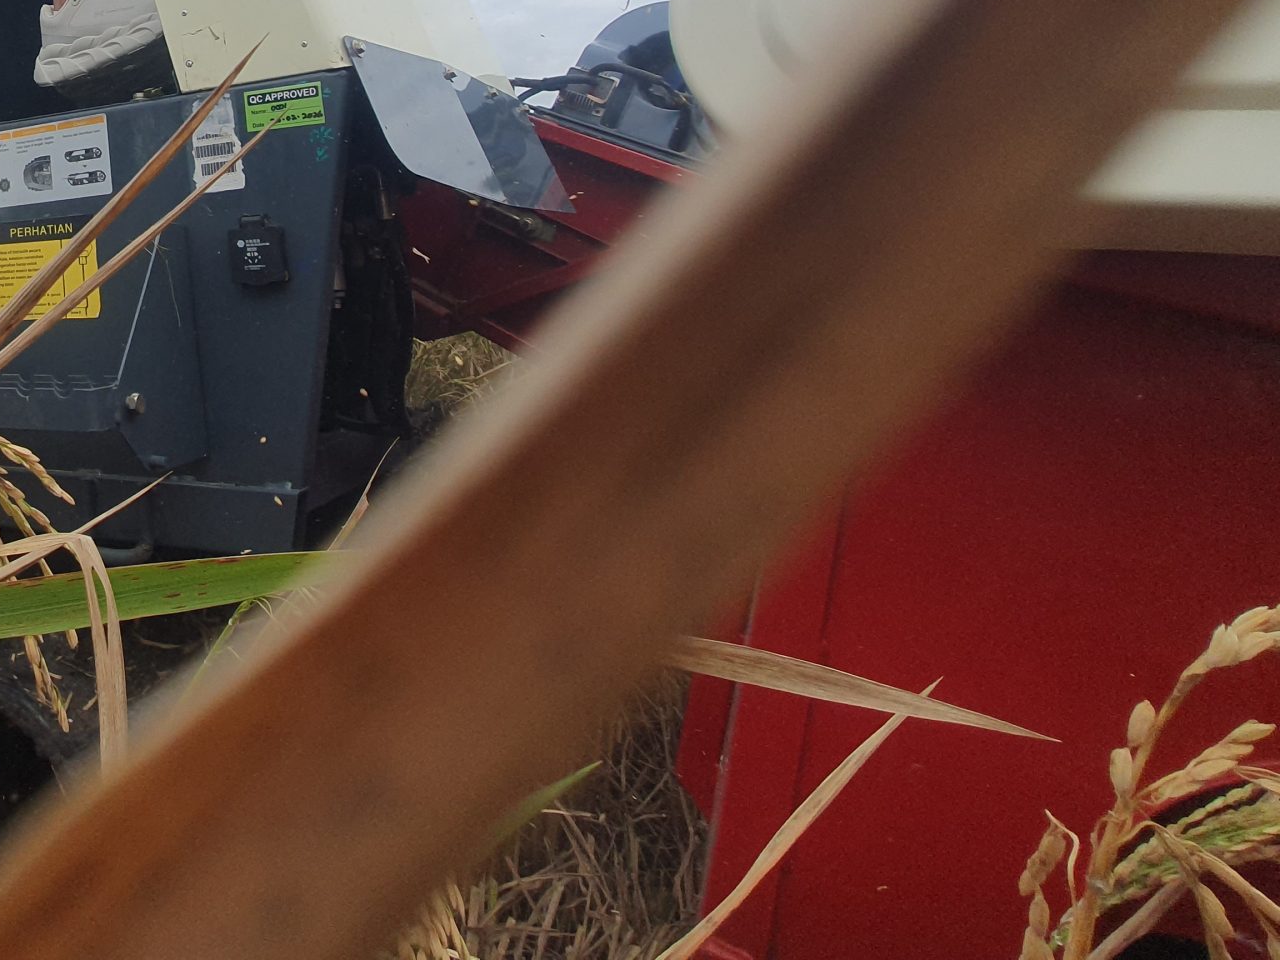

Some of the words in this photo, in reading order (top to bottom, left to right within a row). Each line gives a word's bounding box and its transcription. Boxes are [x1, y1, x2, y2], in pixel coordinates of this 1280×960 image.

[249, 94, 263, 104] QC
[265, 87, 317, 102] APPROVED
[10, 223, 73, 238] PERHATIAN
